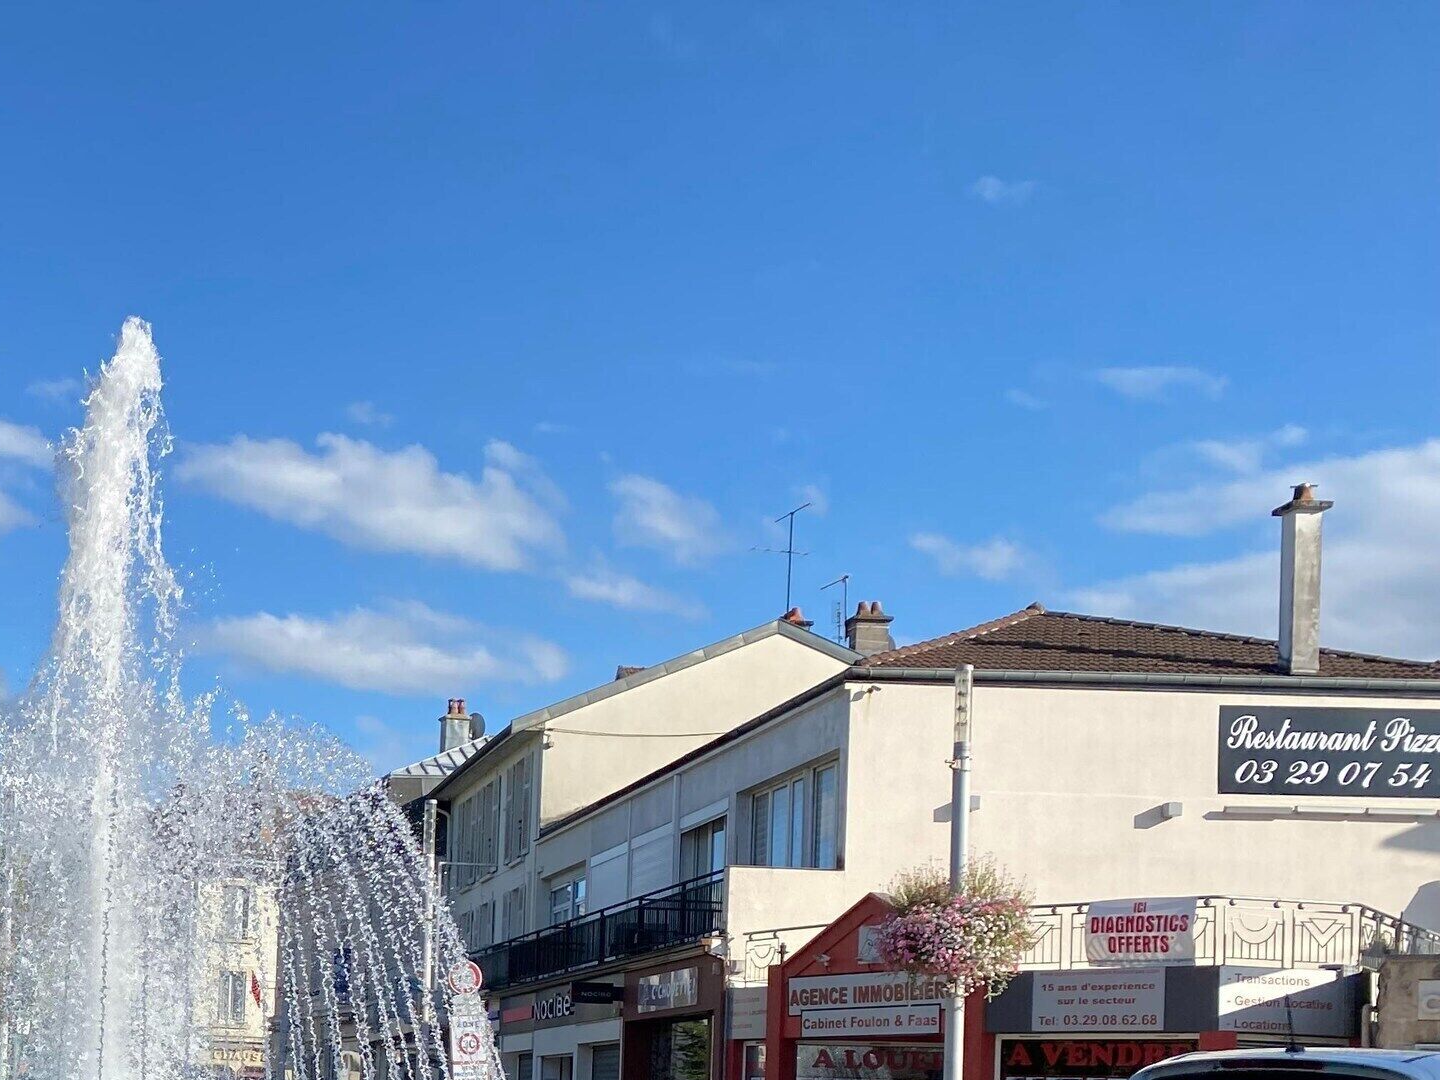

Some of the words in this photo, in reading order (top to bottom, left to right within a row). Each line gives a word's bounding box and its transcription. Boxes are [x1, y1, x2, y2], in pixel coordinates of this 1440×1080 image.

[1227, 715, 1377, 751] Restaurant
[1380, 717, 1440, 753] Pizz
[1234, 759, 1278, 784] 03
[1285, 760, 1330, 784] 29
[1337, 761, 1383, 788] 07
[1388, 763, 1433, 789] 54
[1133, 902, 1147, 913] ICI
[1090, 914, 1189, 934] DIAGNOSTICS
[1041, 983, 1054, 992] 15
[1235, 973, 1310, 987] Transactions
[790, 986, 848, 1007] AGENCE
[852, 981, 949, 1004] IMMOBILIER
[1078, 997, 1089, 1005] le
[1092, 997, 1136, 1005] secteur
[1235, 996, 1280, 1008] Gestion
[1284, 997, 1333, 1011] Locative
[803, 1016, 847, 1030] Cabinet
[850, 1015, 890, 1028] Foulon
[894, 1015, 903, 1027] &
[908, 1014, 938, 1026] Faas
[1063, 1014, 1157, 1026] 03.29.08.62.68
[1234, 1019, 1292, 1031] Locations
[812, 1049, 836, 1069] A
[1008, 1043, 1032, 1066] A
